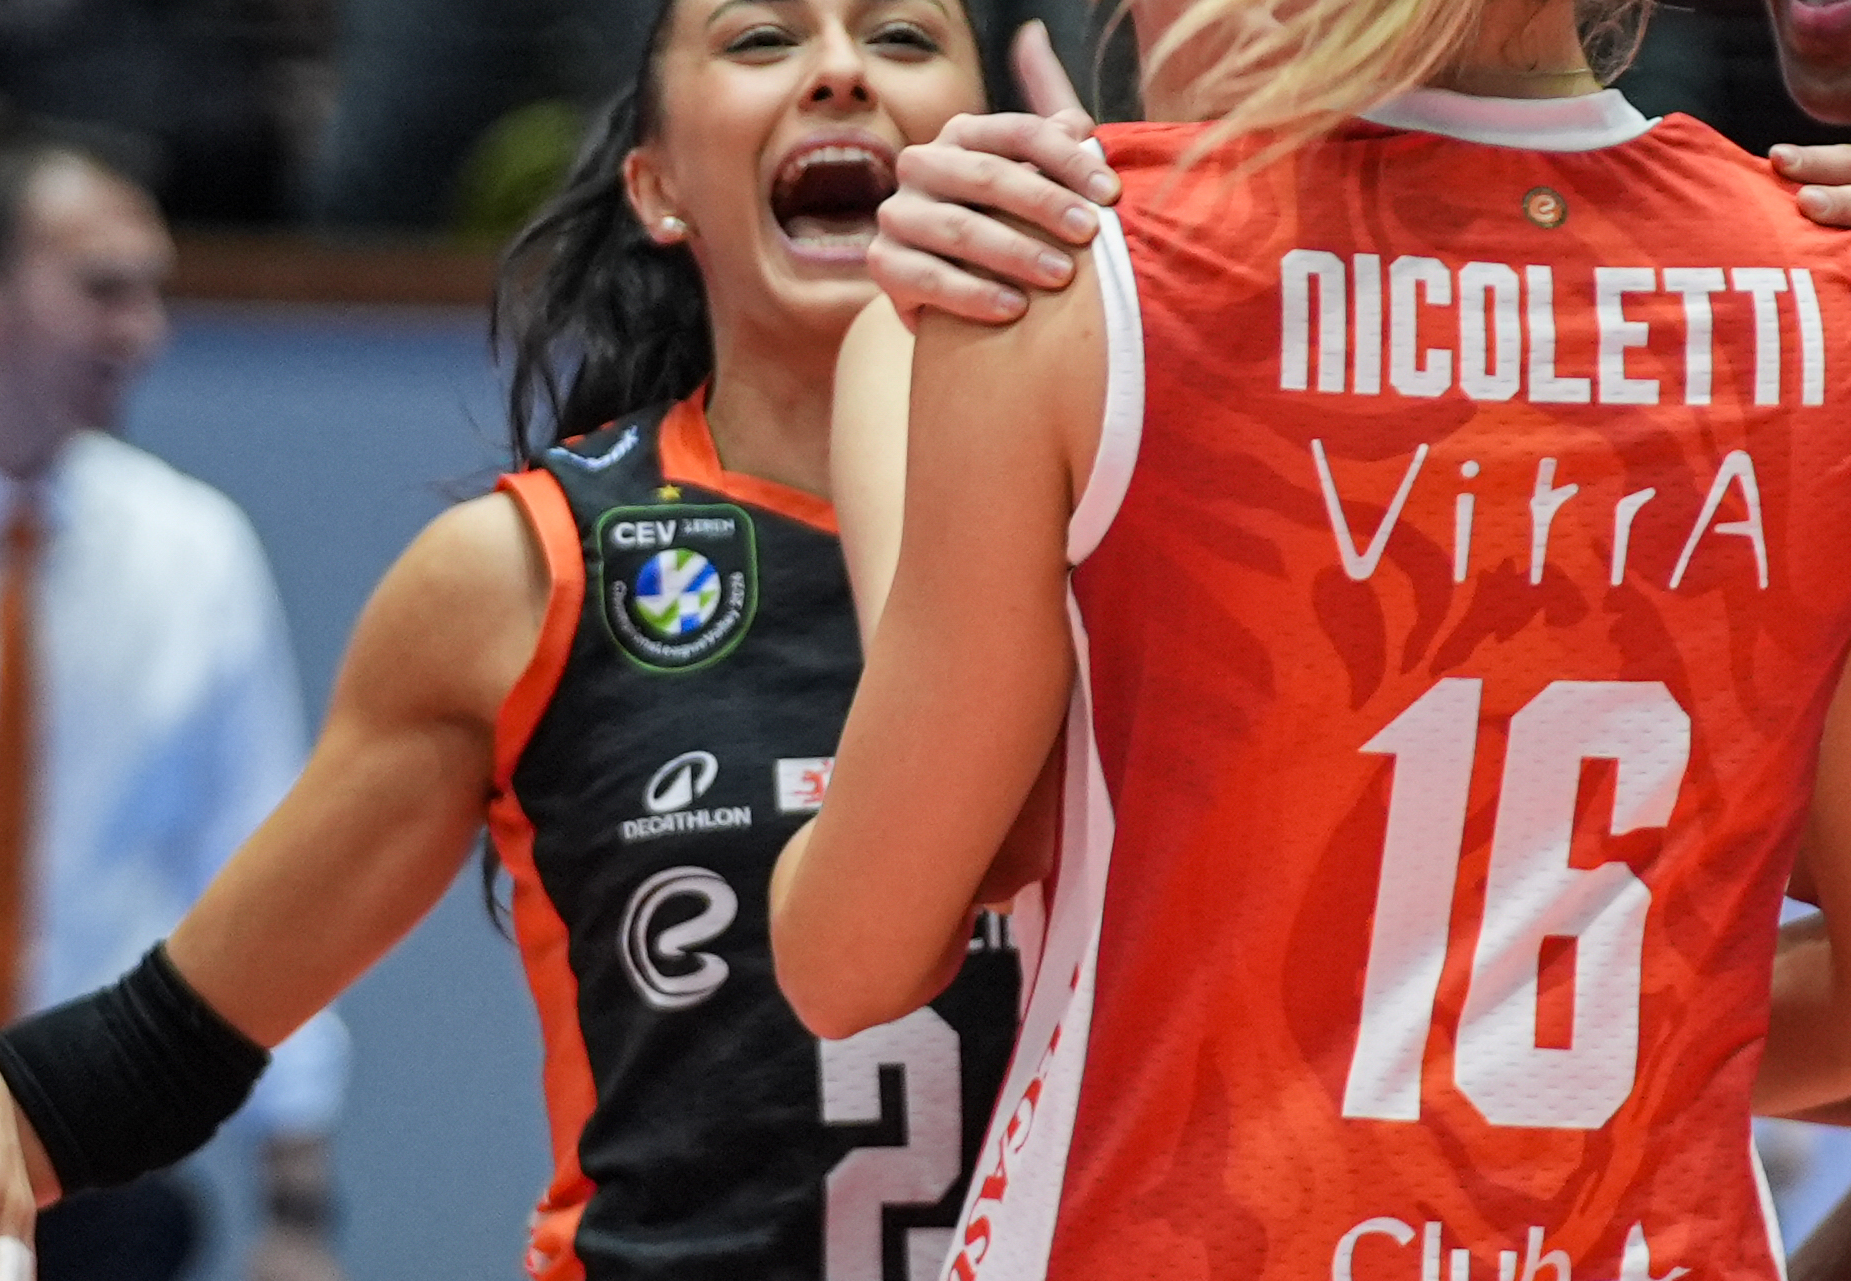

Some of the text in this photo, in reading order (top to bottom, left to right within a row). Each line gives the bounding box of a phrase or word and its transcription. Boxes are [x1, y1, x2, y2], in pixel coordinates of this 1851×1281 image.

[1279, 248, 1824, 406] NICOLETTI
[612, 519, 677, 547] CEV
[1311, 438, 1769, 590] VitrA
[621, 805, 752, 841] DECATHLON
[1342, 677, 1692, 1130] 16
